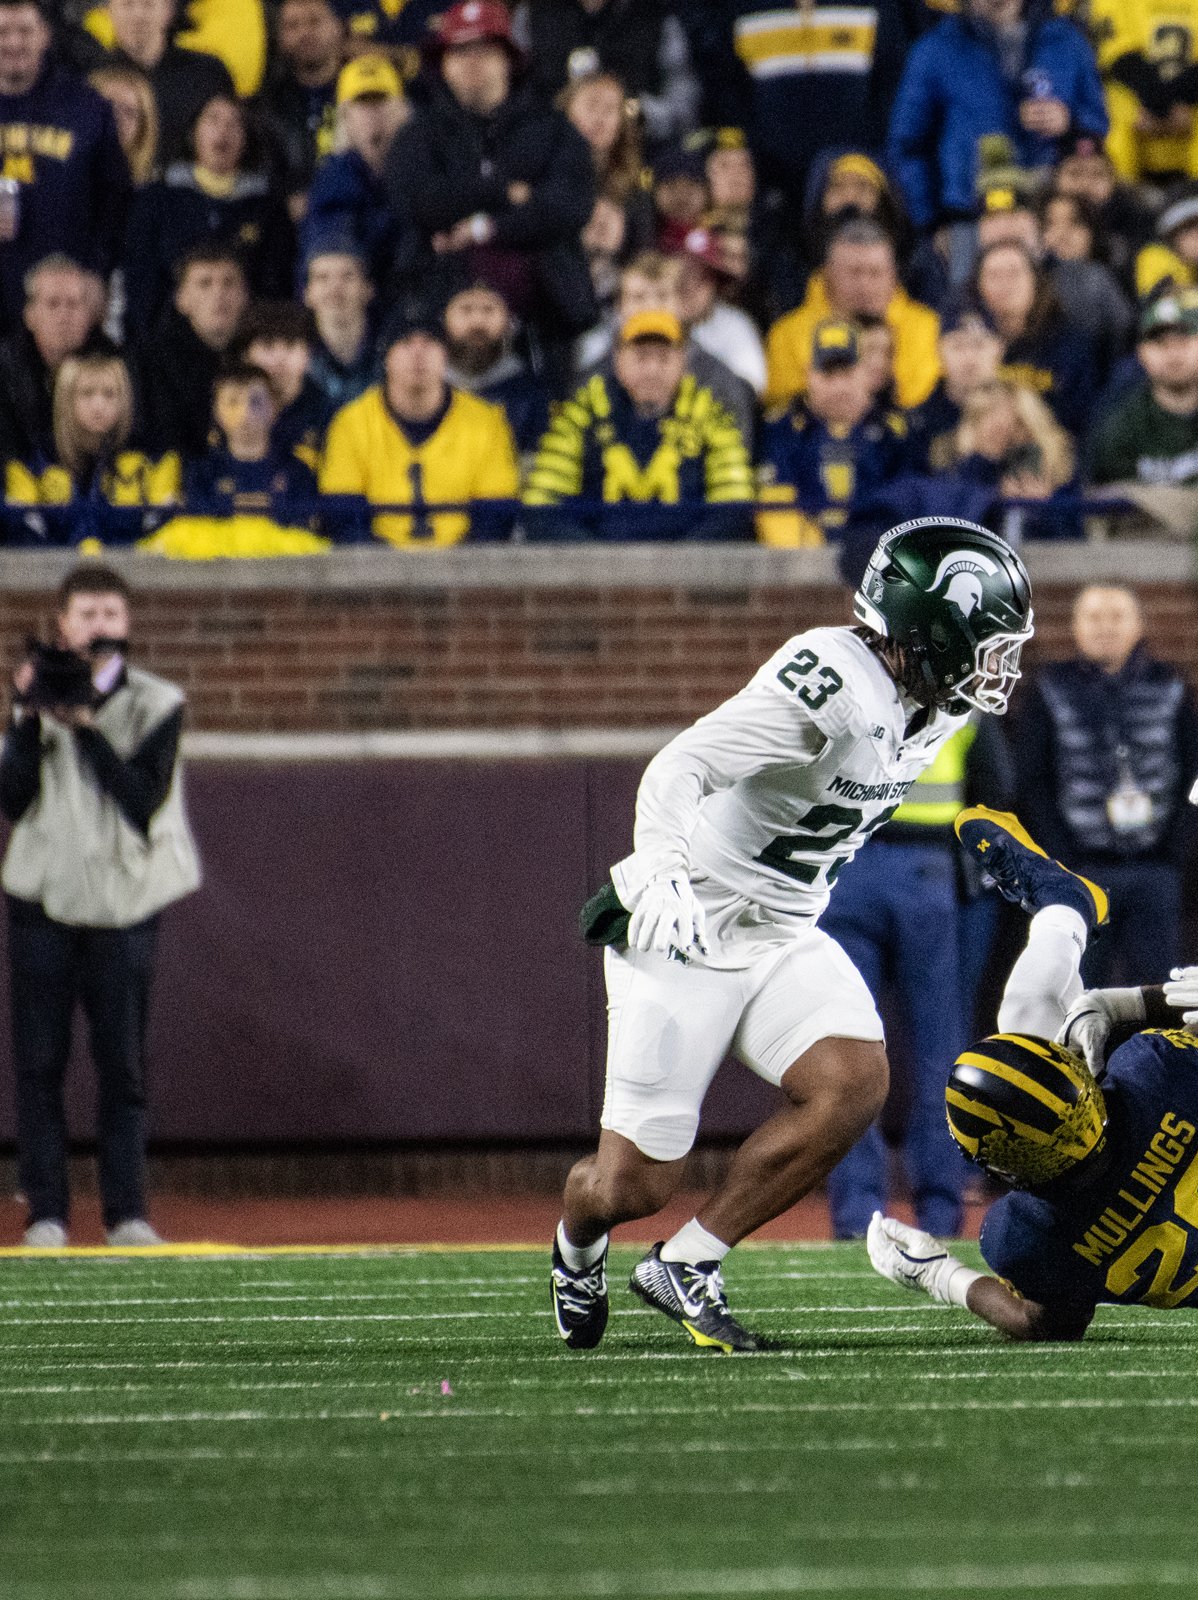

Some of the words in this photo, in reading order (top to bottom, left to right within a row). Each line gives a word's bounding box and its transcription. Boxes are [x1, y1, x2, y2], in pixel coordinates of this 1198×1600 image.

[602, 443, 680, 504] M
[777, 649, 843, 710] 23
[826, 775, 893, 801] MICHIGAN
[1072, 1112, 1196, 1266] MULLINGS
